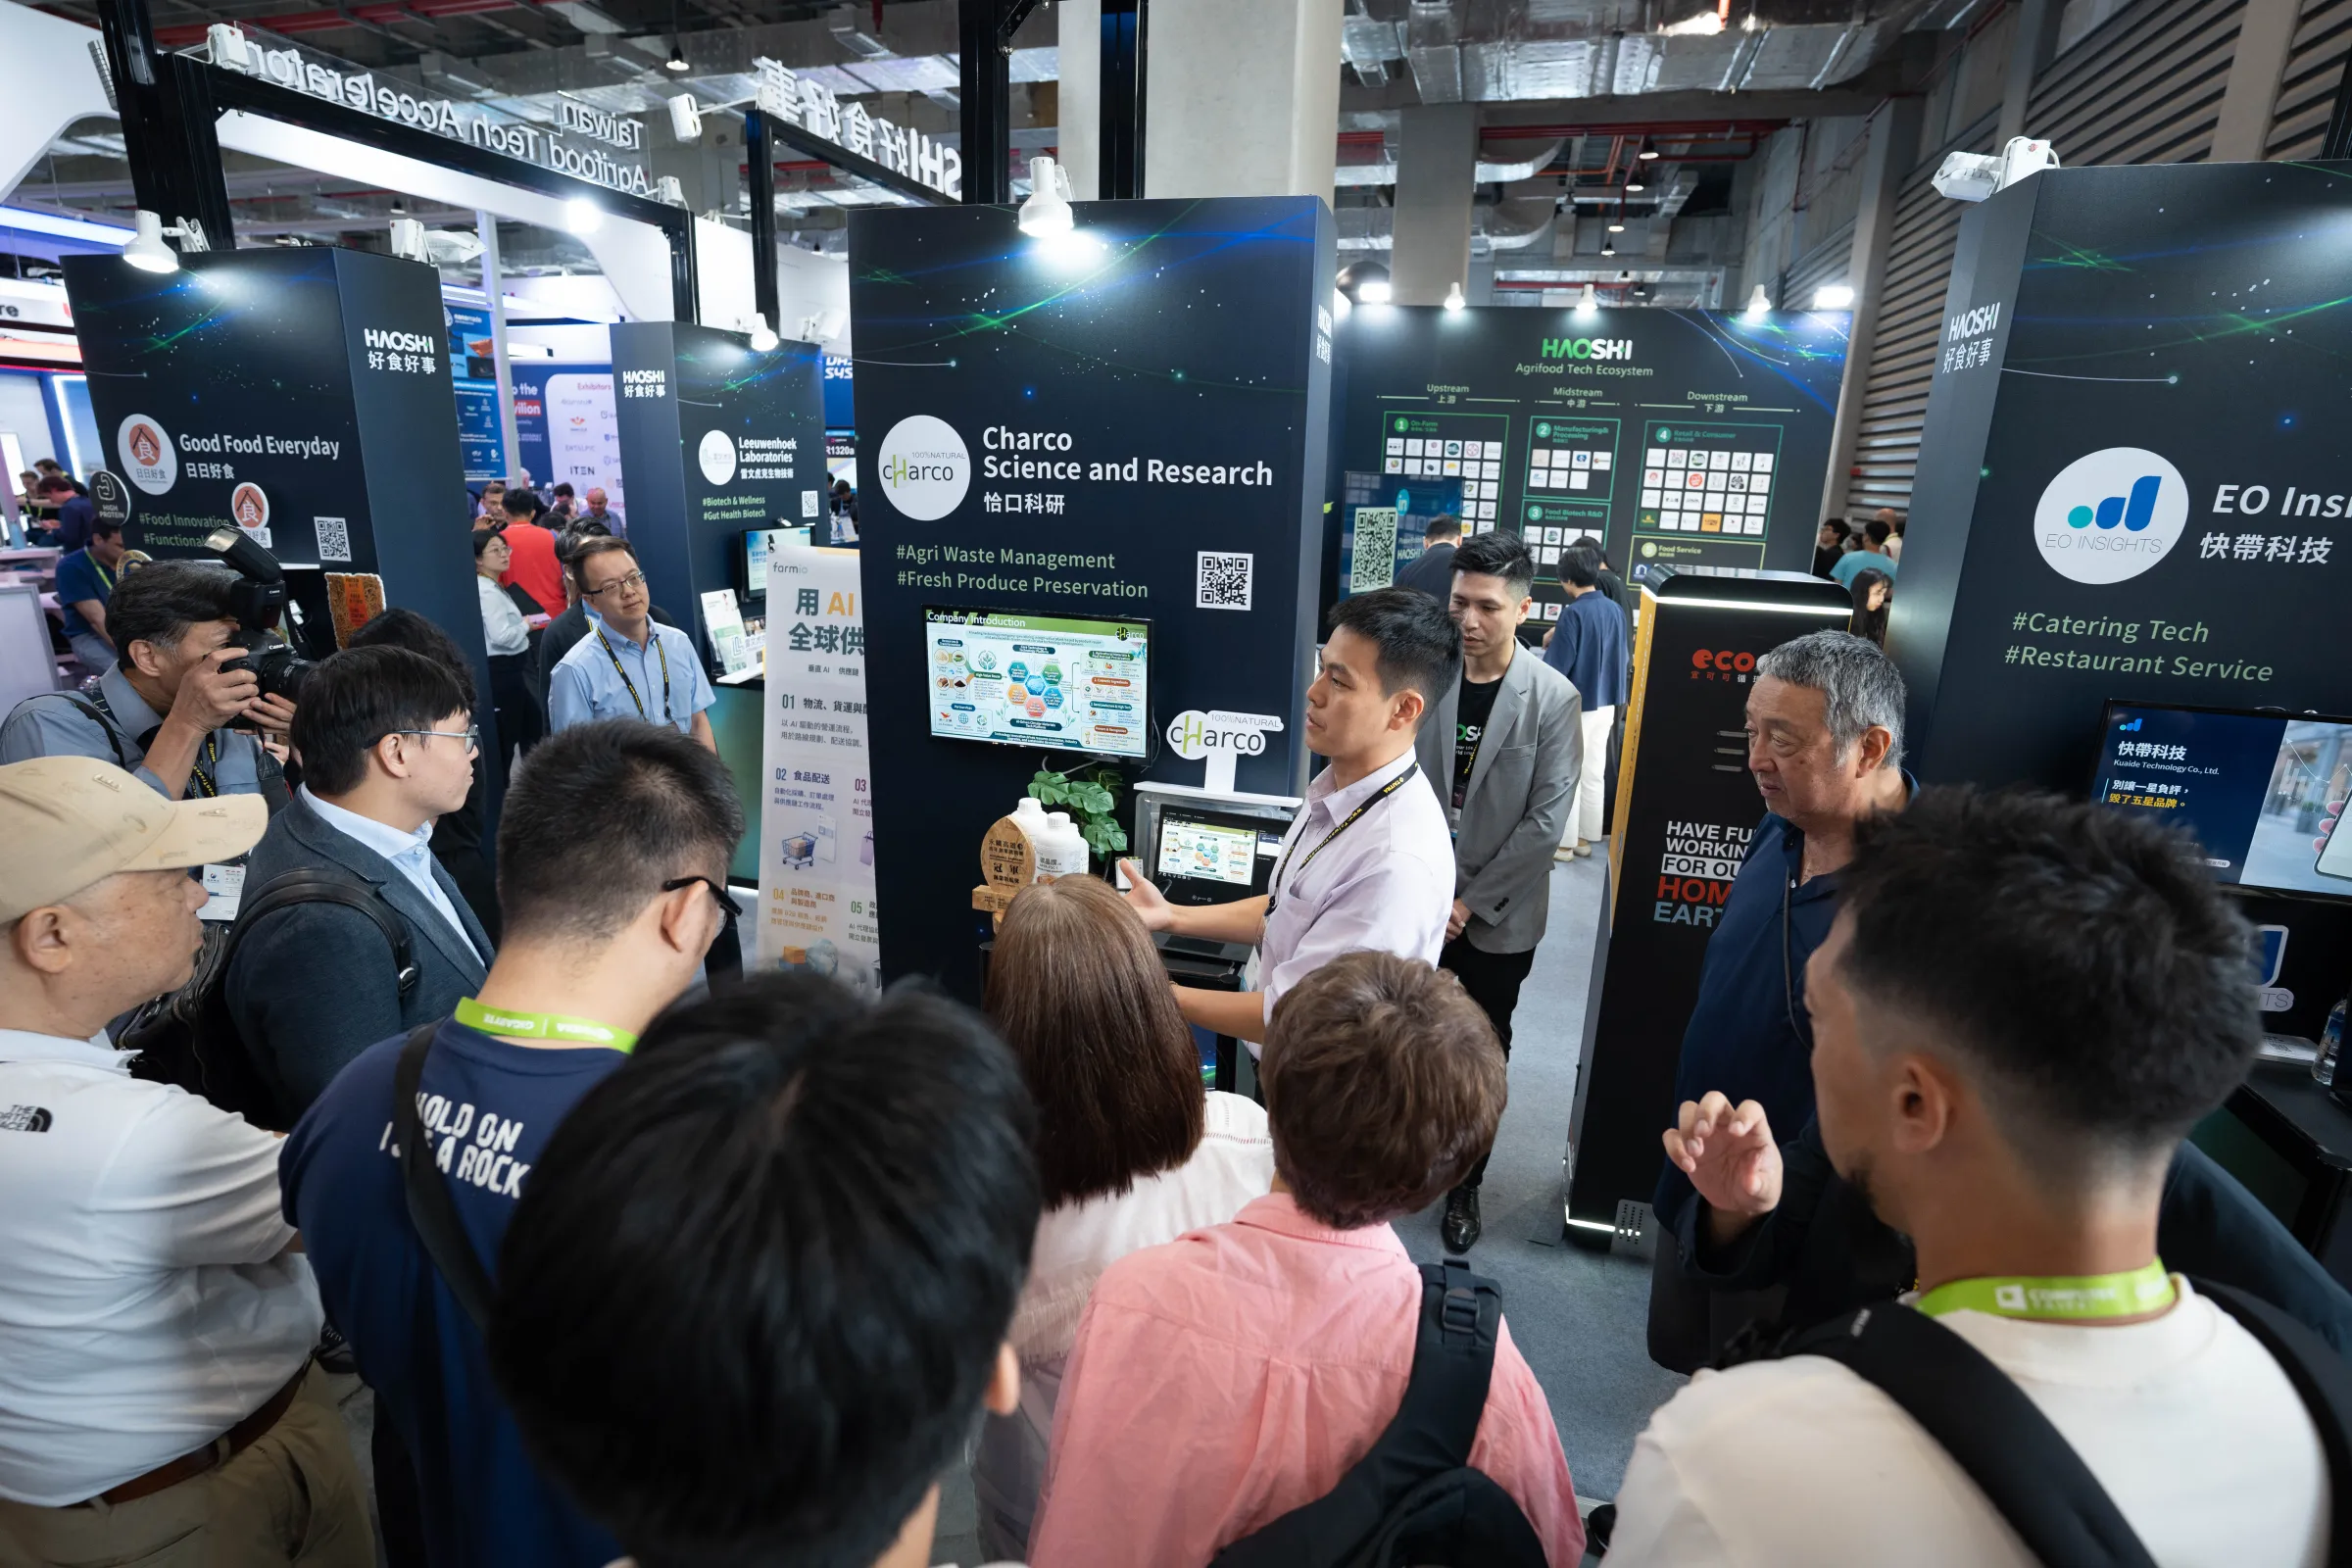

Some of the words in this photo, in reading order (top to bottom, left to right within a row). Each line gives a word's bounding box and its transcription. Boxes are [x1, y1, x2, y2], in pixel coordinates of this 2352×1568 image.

[1947, 301, 2001, 343] HAOSHI
[364, 327, 435, 354] HAOSHI
[1542, 337, 1633, 361] HAOSHI
[368, 349, 437, 374] 好食好事
[1942, 337, 1994, 374] 好食好事
[622, 369, 665, 383] HAOSHI
[1515, 363, 1564, 374] Agrifood
[1567, 364, 1592, 375] Tech
[1595, 365, 1654, 377] Ecosystem
[1427, 383, 1470, 395] Upstream
[1553, 386, 1603, 398] Midstream
[1687, 391, 1748, 402] Downstream
[514, 401, 541, 416] vilion
[982, 424, 1073, 452] Charco
[1540, 424, 1547, 435] 2
[1659, 430, 1668, 439] 4
[179, 432, 221, 453] Good
[223, 433, 264, 455] Food
[266, 436, 340, 460] Everyday
[738, 436, 797, 450] Leeuwenhoek
[739, 450, 794, 464] Laboratories
[911, 451, 966, 460] 100%NATURAL
[185, 462, 236, 480] 日日好食
[983, 454, 1082, 481] Science
[1089, 457, 1139, 482] and
[1147, 459, 1273, 486] Research
[702, 496, 732, 507] #Biotech
[732, 496, 738, 506] &
[738, 495, 765, 505] Wellness
[983, 491, 1065, 515] 恰口科研
[2212, 483, 2271, 515] EO
[138, 512, 172, 526] #Food
[173, 514, 230, 528] Innovation
[703, 511, 720, 521] #Gut
[720, 509, 742, 519] Health
[742, 508, 765, 518] Biotech
[143, 532, 205, 549] #Functional
[2044, 533, 2073, 549] EO
[2078, 535, 2163, 554] INSIGHTS
[2199, 531, 2334, 564] 快帶科技
[896, 544, 939, 565] #Agri
[943, 545, 996, 564] Waste
[1000, 548, 1115, 570] Management
[772, 562, 808, 574] farmio
[897, 569, 953, 589] #Fresh
[957, 573, 1029, 592] Produce
[1033, 576, 1149, 598] Preservation
[795, 587, 819, 616] 用
[826, 591, 855, 616] AI
[927, 612, 969, 625] Company
[970, 614, 1026, 627] Introduction
[2012, 612, 2140, 644] #Catering
[2149, 619, 2209, 643] Tech
[788, 621, 865, 656] 全球供
[822, 665, 830, 674] AI
[2004, 645, 2165, 674] #Restaurant
[2171, 656, 2274, 682] Service
[781, 693, 796, 710] 01
[1211, 713, 1280, 728] 100%NATURAL
[2117, 740, 2187, 761] 快帶科技
[775, 767, 787, 781] 02
[794, 769, 831, 785] 食品配送
[2113, 759, 2141, 768] Kuaide
[2141, 761, 2187, 774] Technology
[2186, 764, 2203, 775] Co.,
[2204, 766, 2220, 775] Ltd.
[854, 778, 867, 792] 03
[2108, 792, 2186, 809] 毀了五星品牌。
[1666, 820, 1721, 840] HAVE
[1725, 826, 1757, 844] FU
[1666, 837, 1749, 859] WORKIN
[1663, 857, 1707, 875] FOR
[1712, 861, 1740, 879] OU
[772, 887, 785, 902] 04
[1657, 875, 1734, 906] HOM
[851, 900, 862, 914] 05
[1653, 901, 1724, 928] EAR
[415, 1091, 475, 1139] HOLD
[475, 1112, 524, 1153] ON
[436, 1136, 458, 1174] A
[456, 1144, 531, 1200] ROCK
